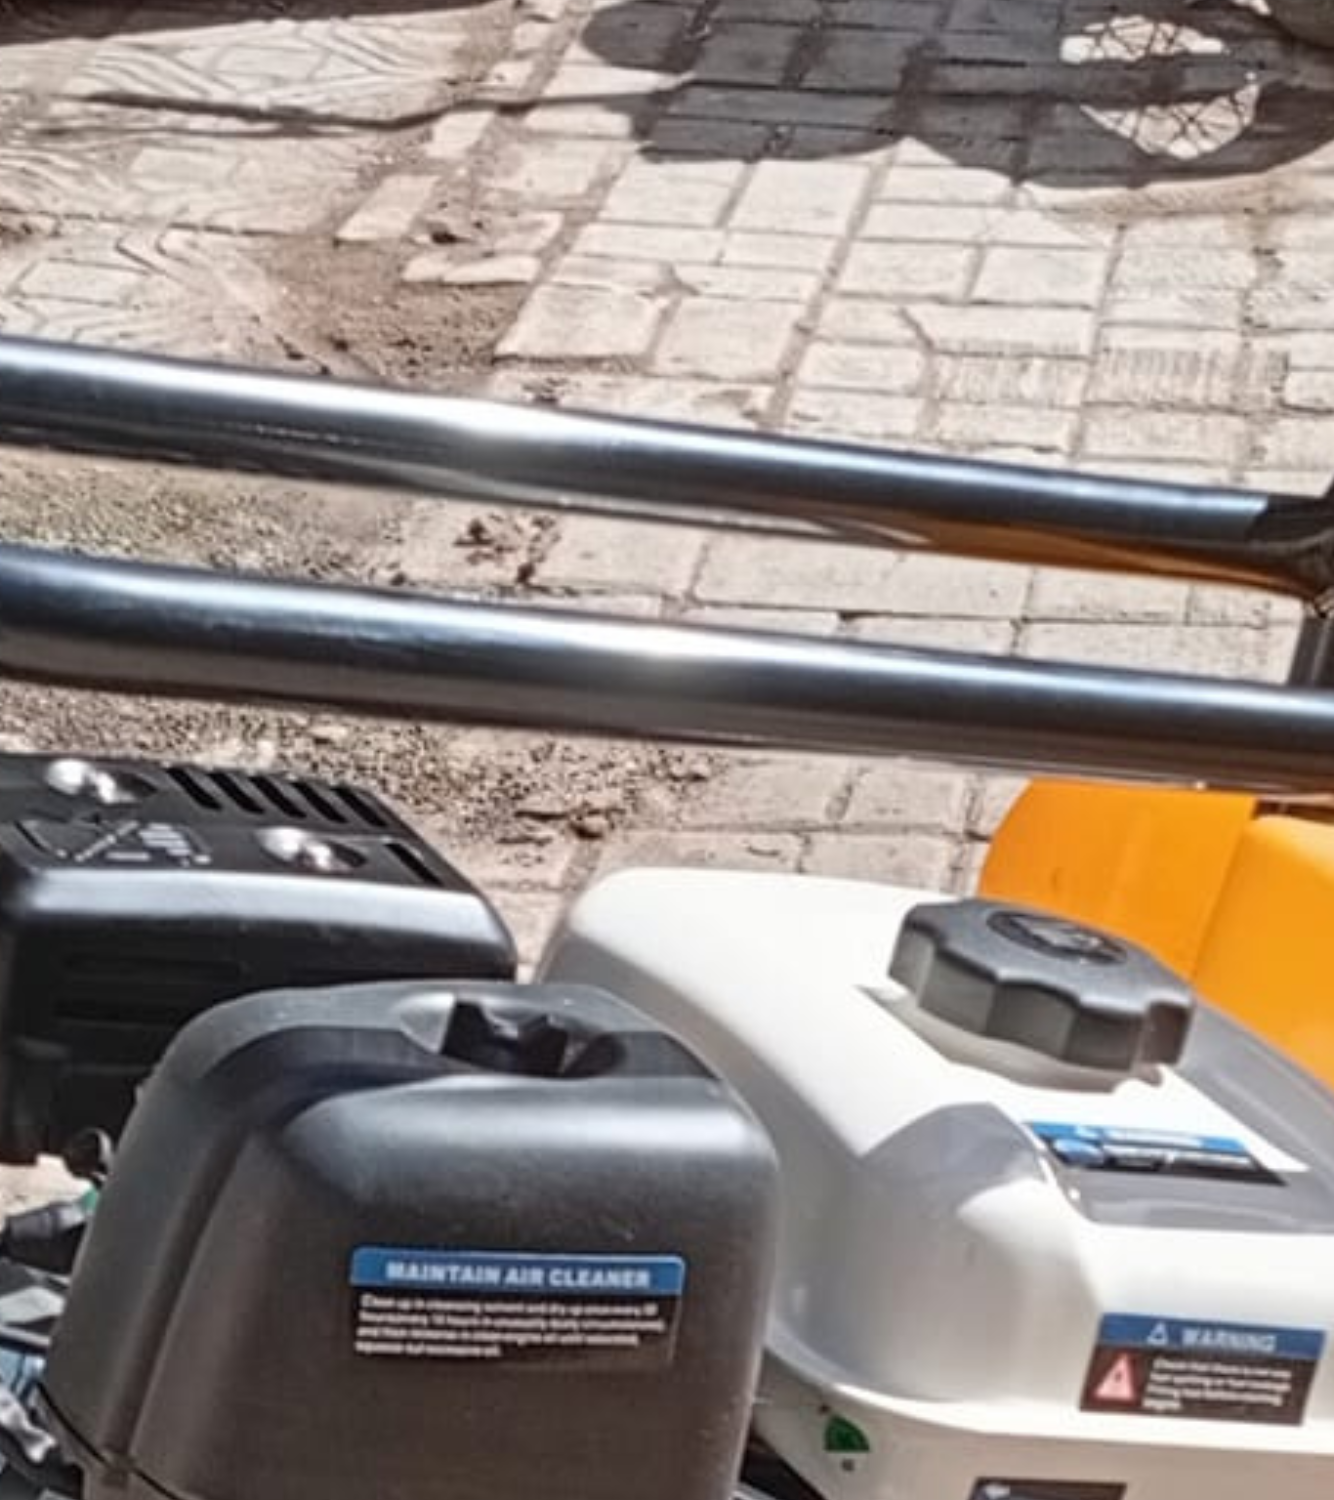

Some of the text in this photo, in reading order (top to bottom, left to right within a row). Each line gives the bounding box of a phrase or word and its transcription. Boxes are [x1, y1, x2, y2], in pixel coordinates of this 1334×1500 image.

[385, 1261, 651, 1290] MAINTAIN AIR CLEANER
[1181, 1327, 1277, 1352] WARNING
